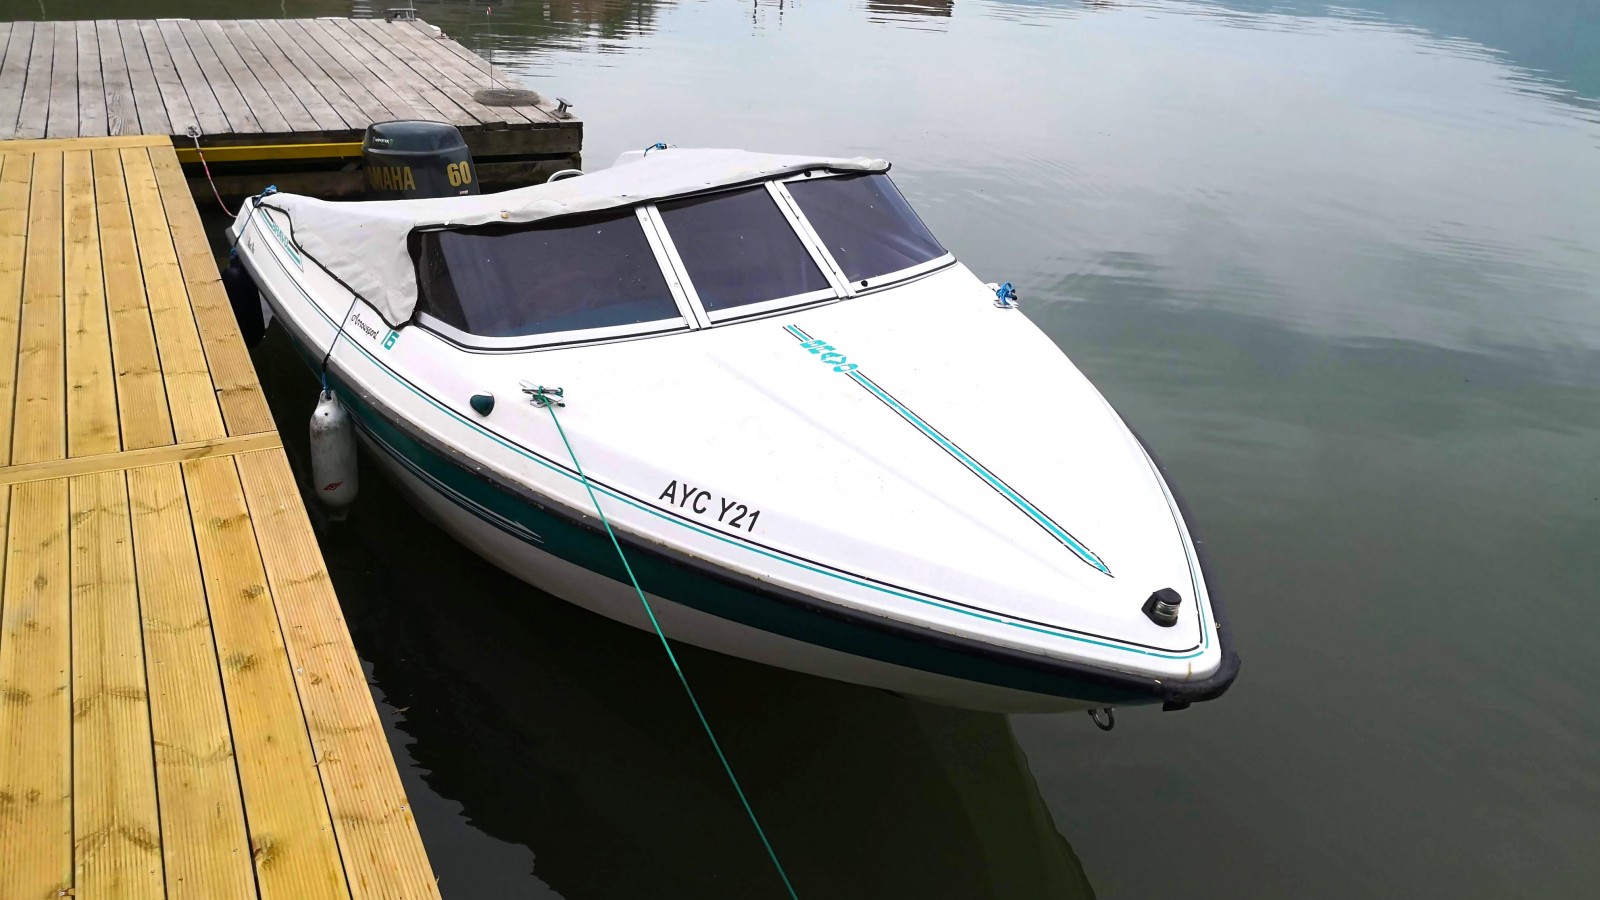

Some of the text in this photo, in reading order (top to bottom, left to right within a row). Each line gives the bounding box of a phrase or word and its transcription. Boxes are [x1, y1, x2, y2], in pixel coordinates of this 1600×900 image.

[367, 166, 416, 190] MAHA
[447, 161, 472, 187] 60
[658, 480, 761, 533] AYC Y21
